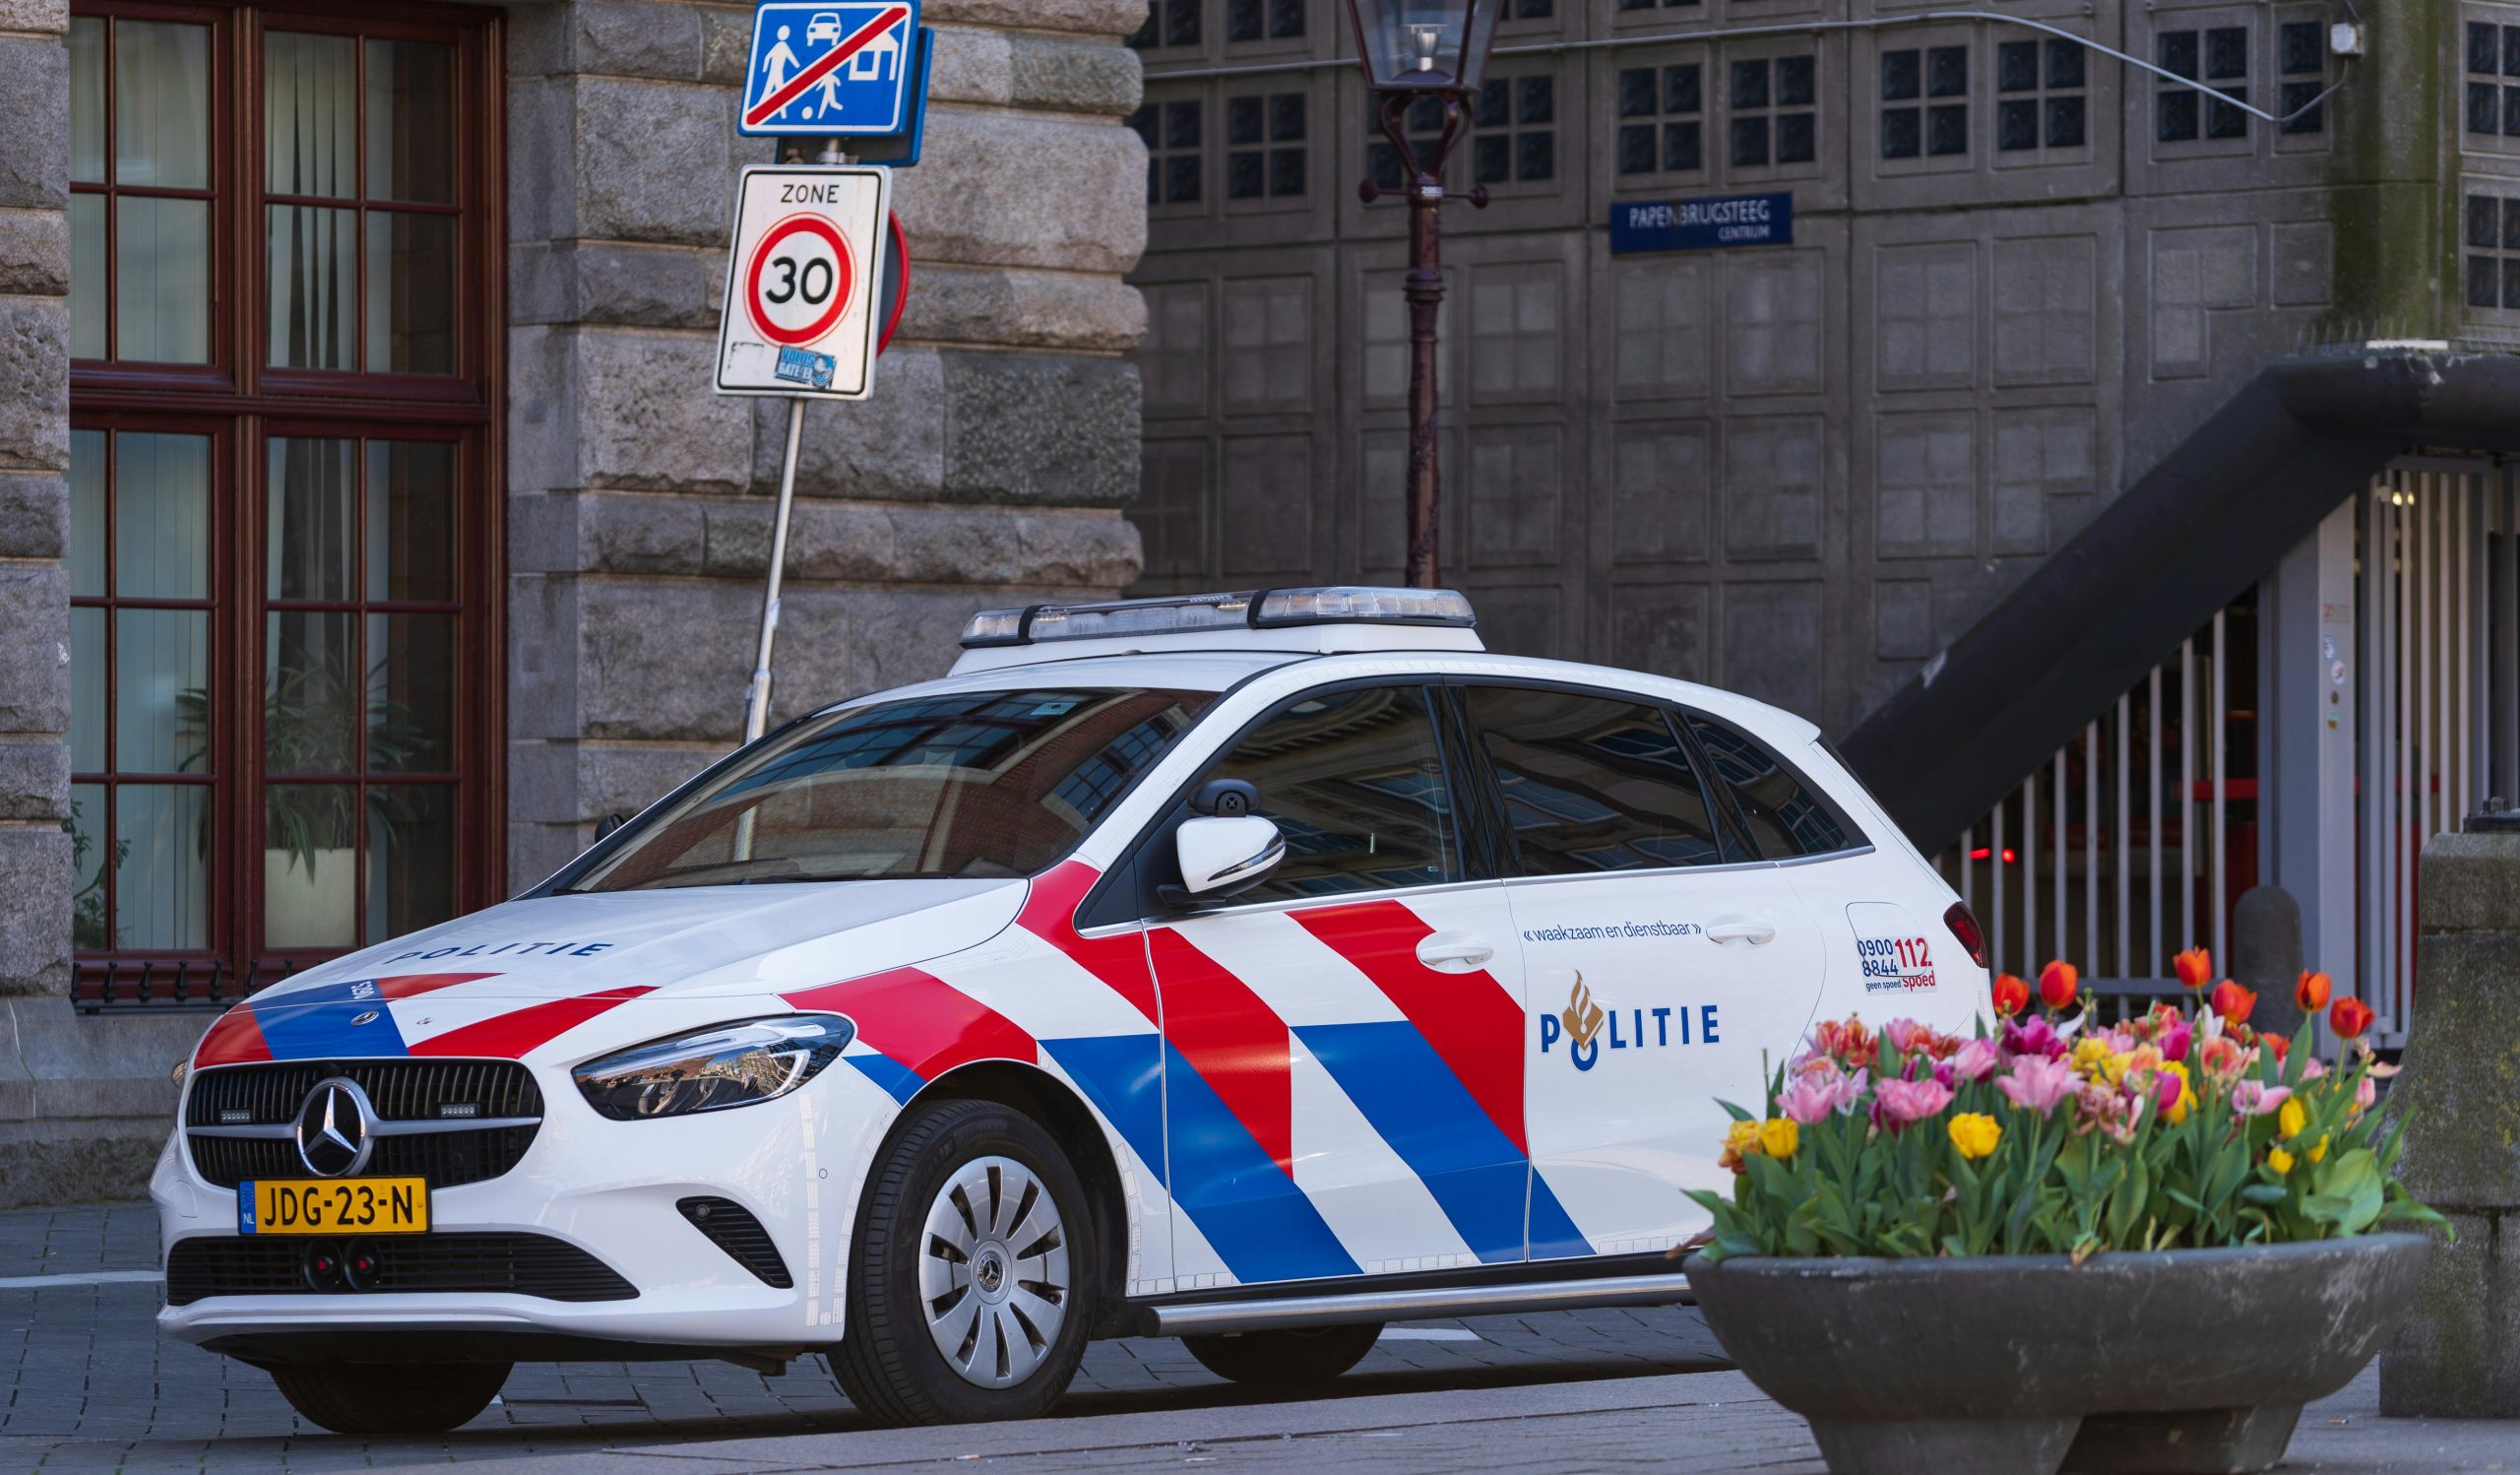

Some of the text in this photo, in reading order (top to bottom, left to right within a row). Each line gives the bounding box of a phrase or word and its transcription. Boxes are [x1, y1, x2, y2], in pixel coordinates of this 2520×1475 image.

[781, 184, 840, 203] ZONE
[1718, 224, 1770, 240] CENTRUM
[765, 256, 833, 305] 30
[1533, 924, 1606, 941] waakzaam
[1606, 927, 1623, 938] en
[1623, 921, 1691, 937] dienstbaar
[383, 942, 614, 964] POLITIE
[1858, 938, 1893, 956] 0900
[1862, 959, 1898, 977] 8844
[1866, 980, 1901, 992] geen spoed
[1903, 970, 1935, 992] spoed
[1541, 1005, 1720, 1071] POLITIE
[265, 1186, 413, 1227] JDG-23-N
[243, 1212, 255, 1225] NL
